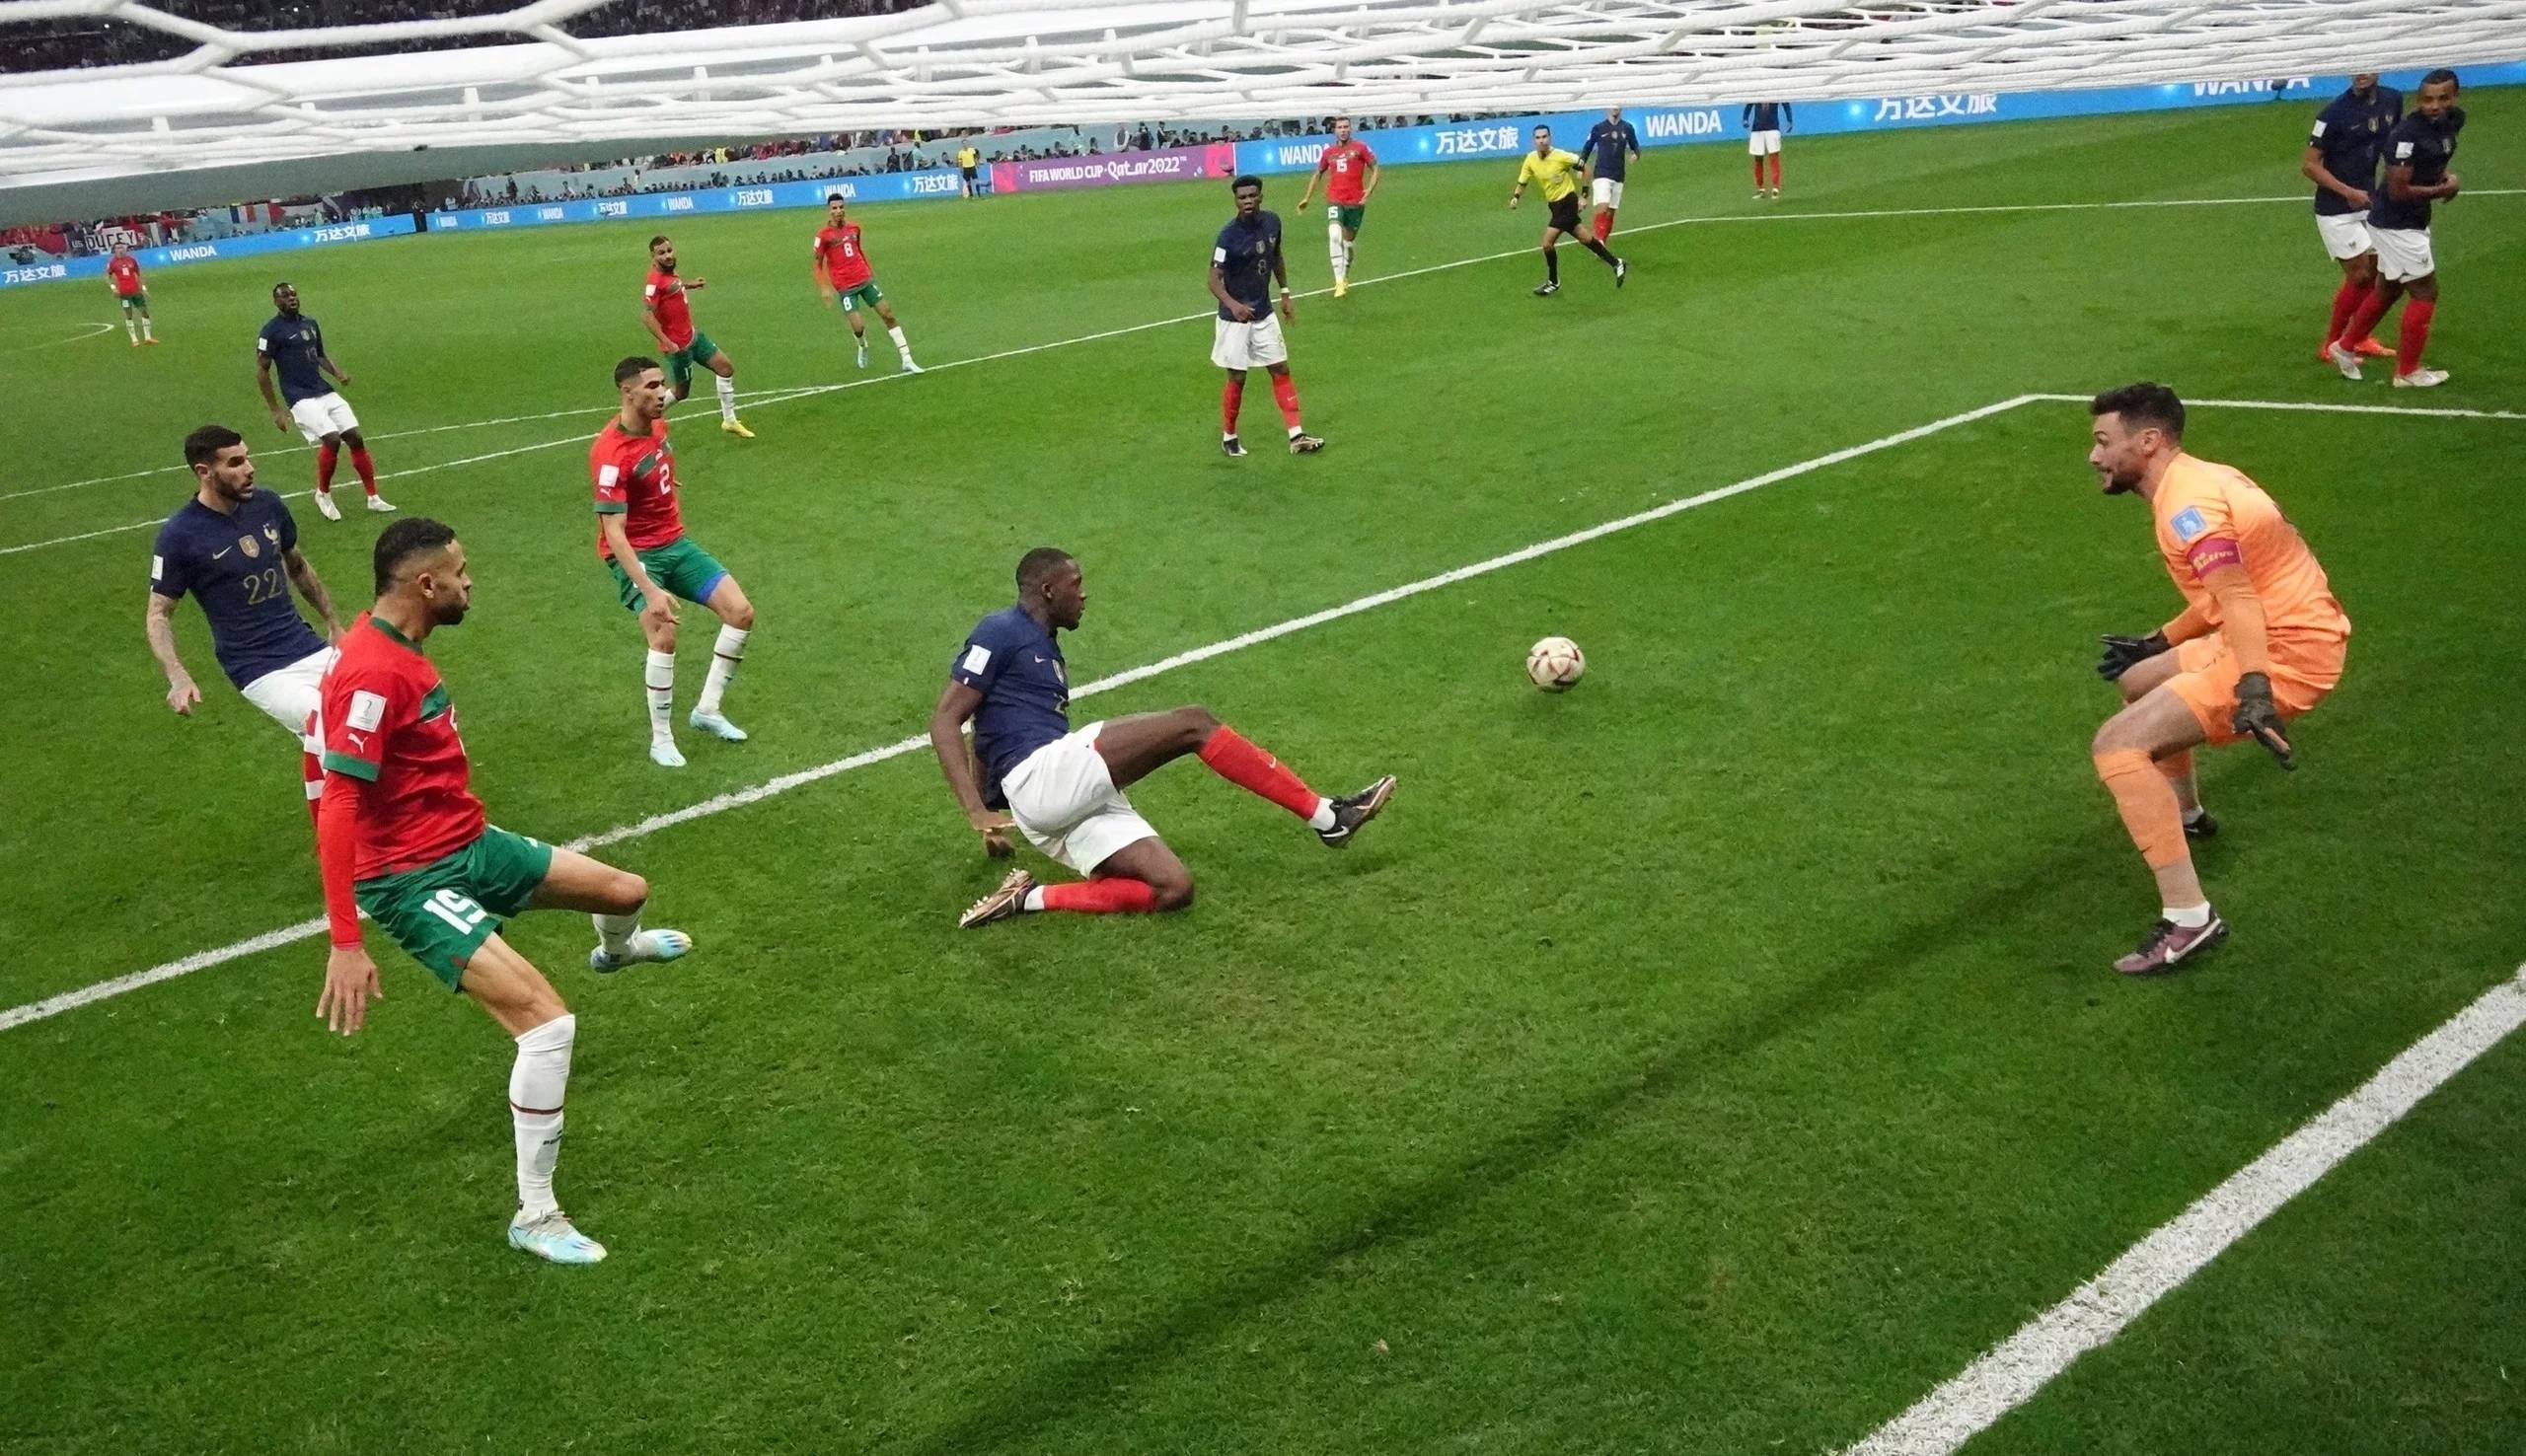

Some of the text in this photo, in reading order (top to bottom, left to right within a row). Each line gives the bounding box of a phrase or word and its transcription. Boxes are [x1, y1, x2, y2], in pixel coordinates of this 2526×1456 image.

[2193, 78, 2310, 96] WANA
[1646, 109, 1722, 138] WANDA
[1436, 126, 1519, 155] 万达文旅
[1029, 169, 1051, 183] FIFA
[1050, 166, 1083, 181] WORLD
[1084, 164, 1104, 180] CUP
[1336, 158, 1348, 173] 15
[913, 174, 958, 193] 万达文旅
[667, 196, 694, 211] WANDA
[314, 224, 370, 244] 万达文旅
[170, 245, 217, 261] WANDA
[844, 243, 853, 258] 8
[3, 264, 66, 284] 万达文旅
[842, 296, 853, 312] 8
[658, 463, 671, 495] 2
[243, 568, 283, 606] 22
[422, 889, 488, 936] 19
